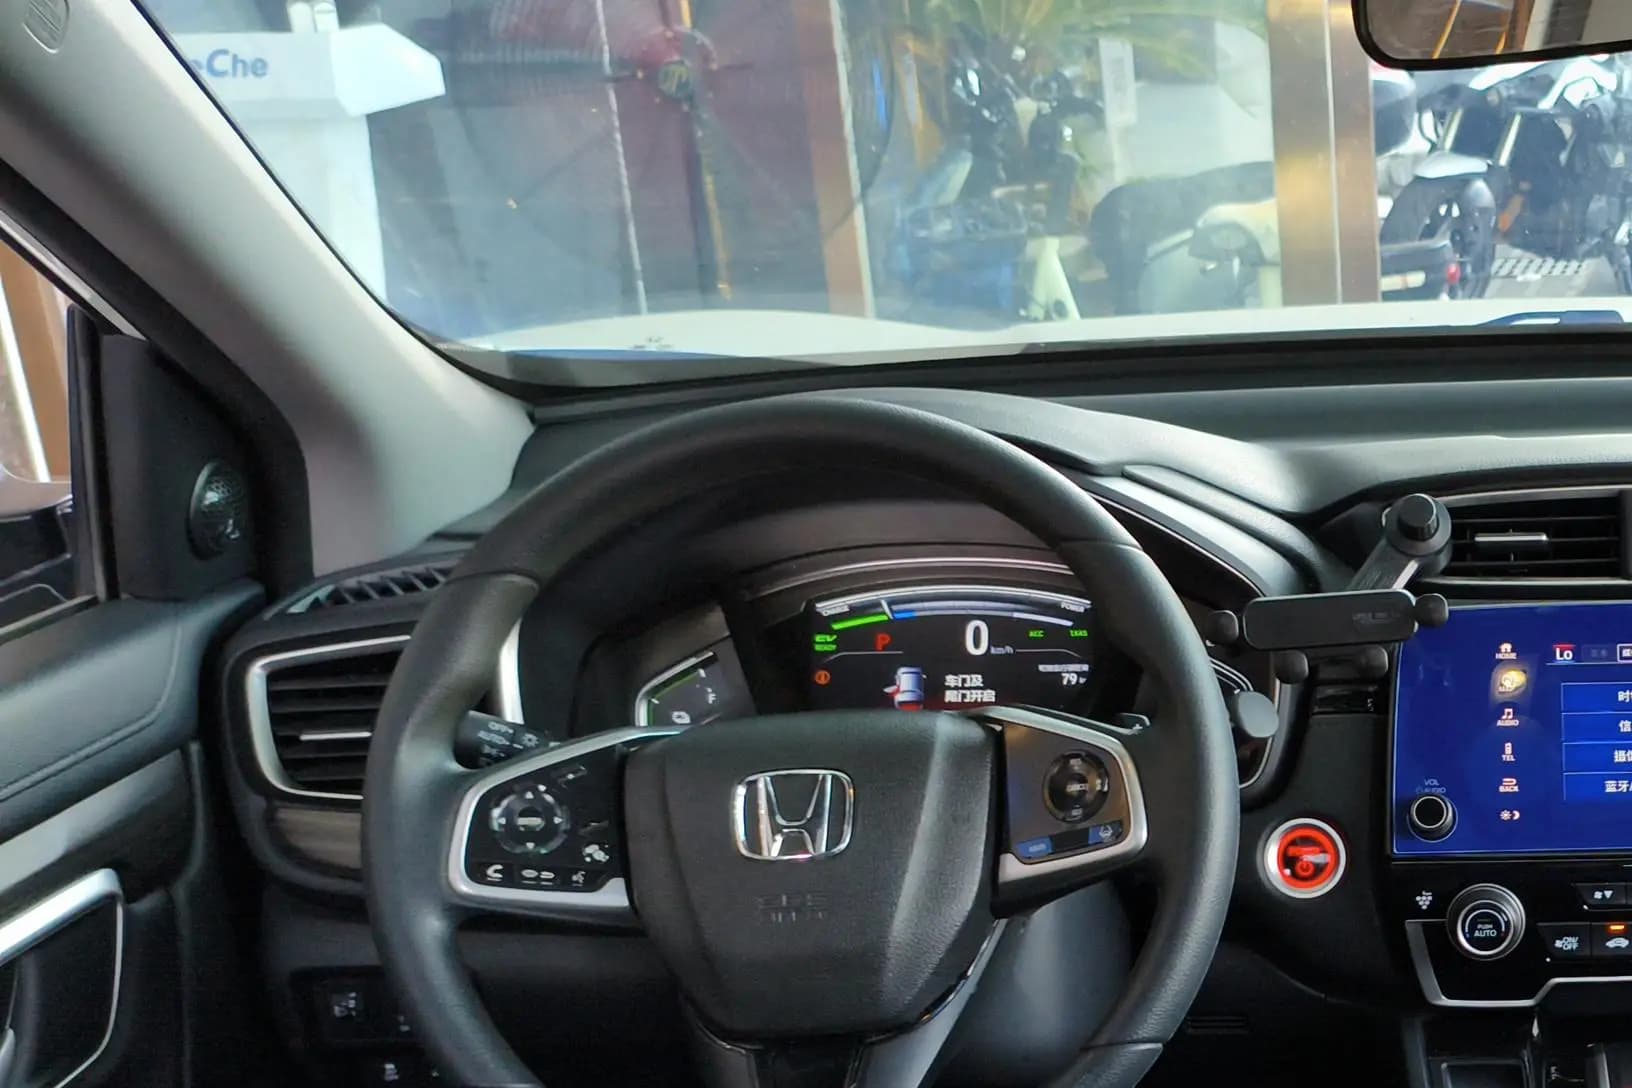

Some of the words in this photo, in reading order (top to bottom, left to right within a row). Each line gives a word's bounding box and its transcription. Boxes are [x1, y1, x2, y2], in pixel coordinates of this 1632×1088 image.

[876, 634, 891, 651] P
[965, 619, 989, 656] 0
[1555, 647, 1573, 660] Lo
[944, 674, 984, 687] 车门及
[1061, 673, 1078, 685] 79
[944, 689, 996, 703] 尾门开启
[1473, 929, 1498, 938] AUTO
